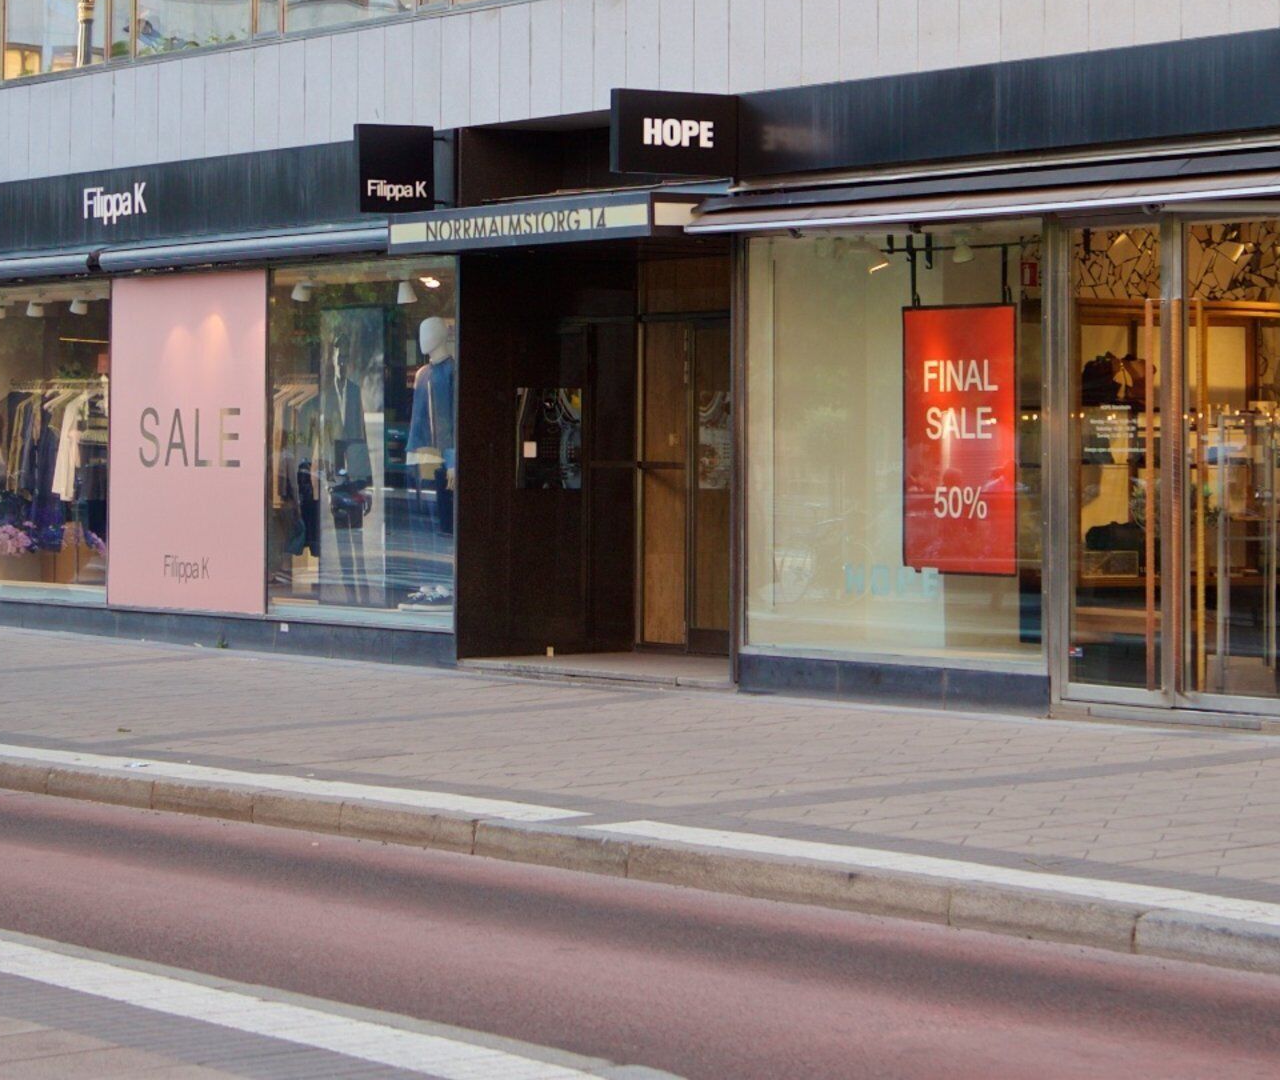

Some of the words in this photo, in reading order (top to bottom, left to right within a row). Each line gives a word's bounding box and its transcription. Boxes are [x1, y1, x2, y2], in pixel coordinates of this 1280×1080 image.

[643, 117, 714, 149] HOPE
[84, 186, 132, 225] Filippa
[133, 182, 147, 214] K
[367, 179, 412, 200] Filippa
[415, 181, 427, 198] K
[426, 209, 581, 241] NORRMALMSTORG
[589, 207, 607, 231] 14
[923, 359, 998, 393] FINAL
[139, 407, 241, 468] SALE
[926, 407, 993, 440] SALE
[933, 486, 988, 520] 50%
[163, 554, 200, 583] Filippa
[201, 556, 210, 579] K
[845, 563, 939, 597] HOPE
